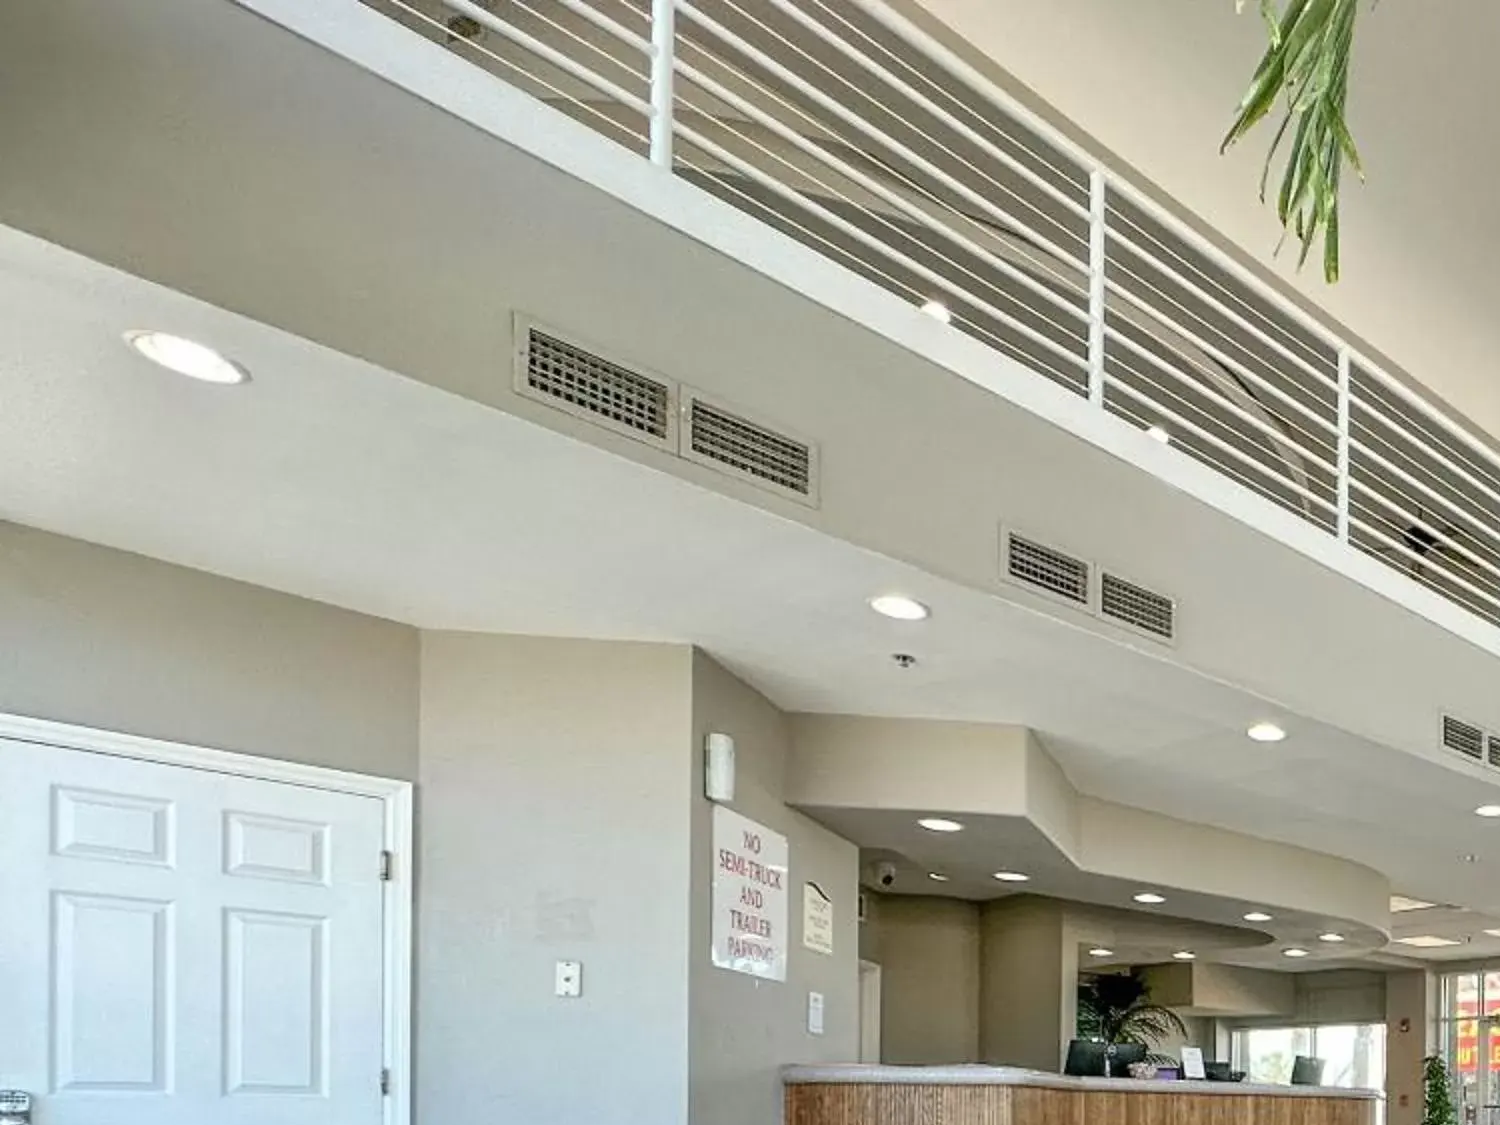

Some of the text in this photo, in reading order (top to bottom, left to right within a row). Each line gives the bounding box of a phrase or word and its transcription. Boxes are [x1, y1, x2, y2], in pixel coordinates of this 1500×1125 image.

[743, 830, 761, 854] NO
[719, 847, 782, 890] SEMI-TRUCK
[740, 885, 763, 909] AND
[729, 909, 771, 938] TRAILER
[728, 936, 773, 962] PARKING
